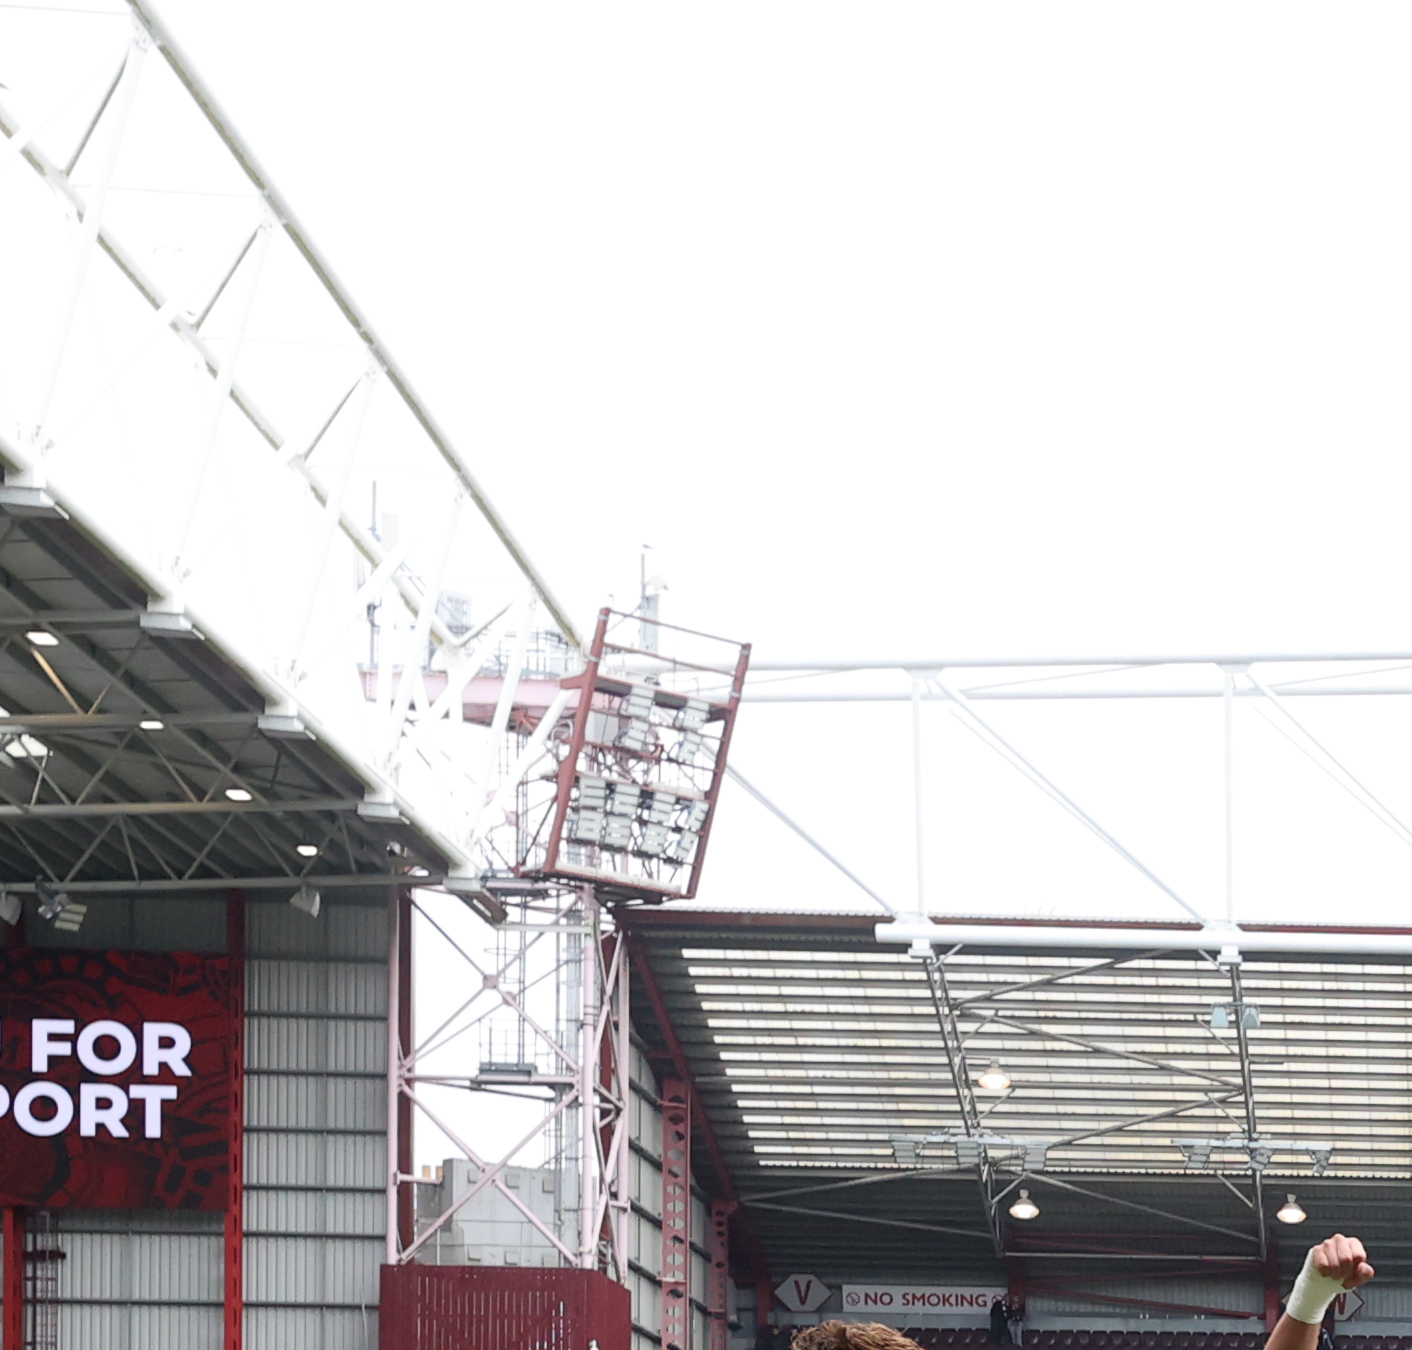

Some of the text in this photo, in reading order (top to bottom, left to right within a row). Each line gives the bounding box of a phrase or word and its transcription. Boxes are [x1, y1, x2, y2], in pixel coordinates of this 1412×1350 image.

[31, 1018, 192, 1077] FOR
[0, 1080, 178, 1139] ORT
[793, 1279, 813, 1306] V
[864, 1291, 987, 1307] NO SMOKING
